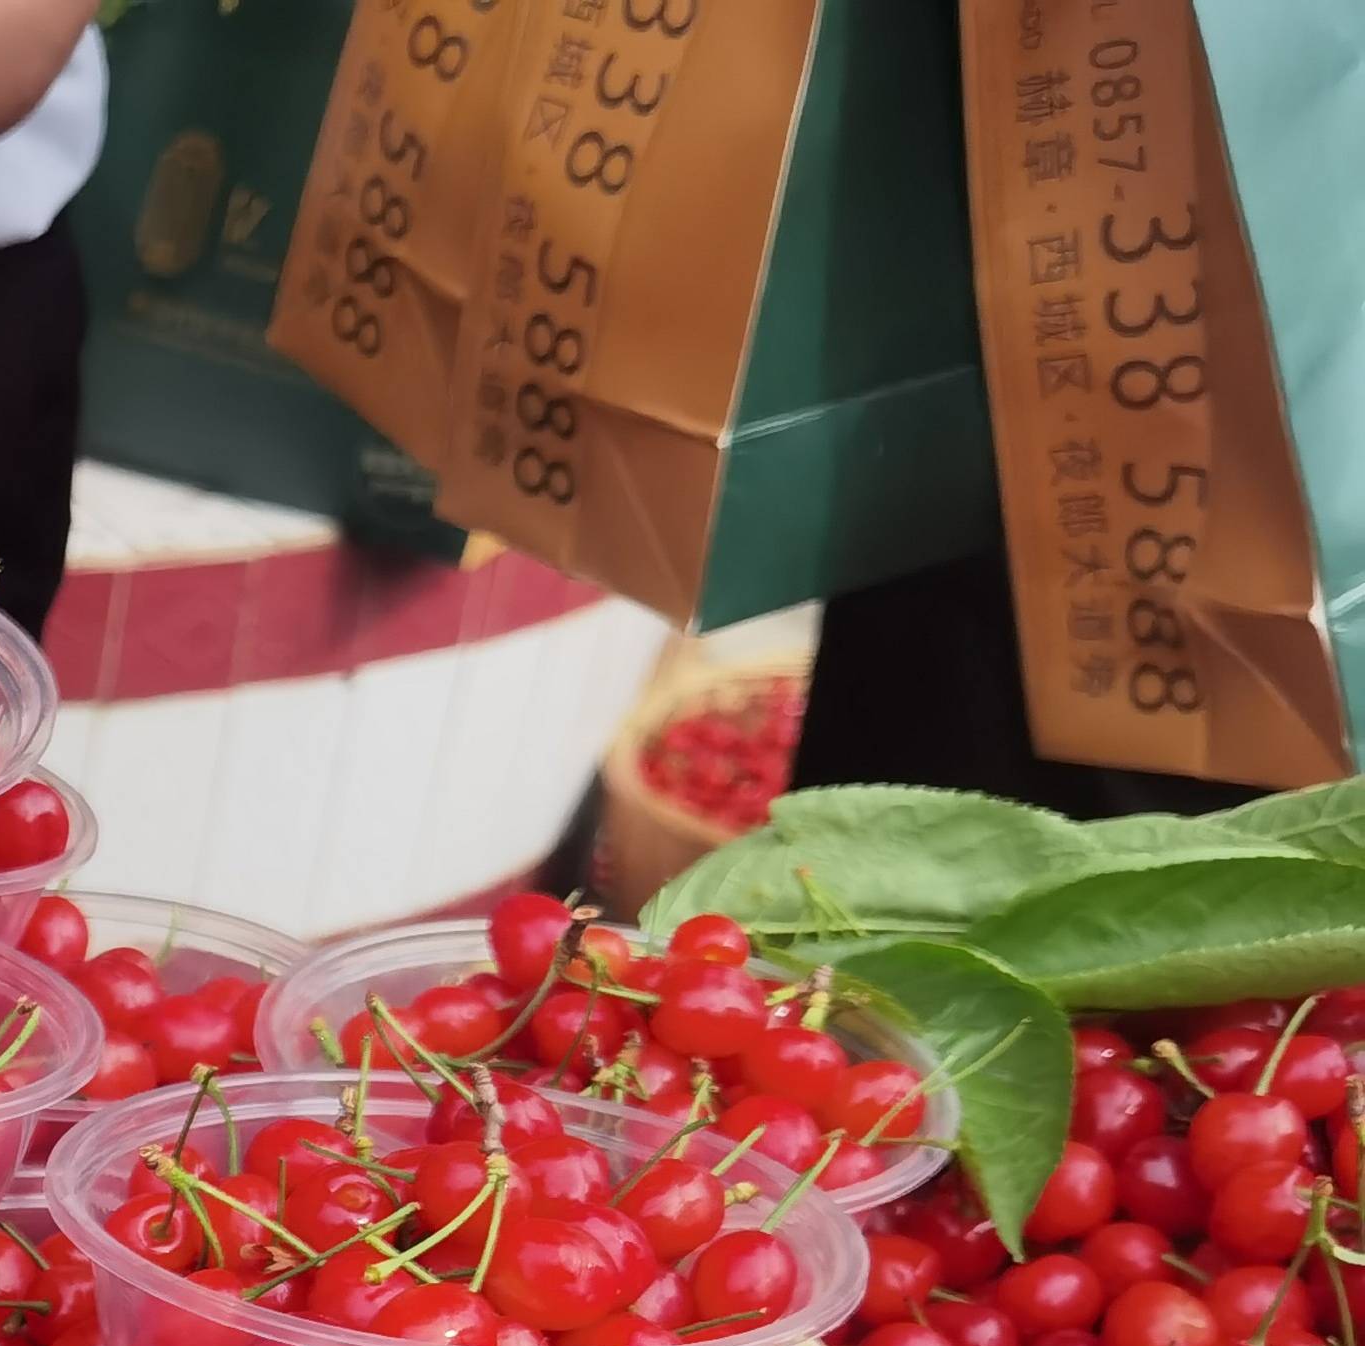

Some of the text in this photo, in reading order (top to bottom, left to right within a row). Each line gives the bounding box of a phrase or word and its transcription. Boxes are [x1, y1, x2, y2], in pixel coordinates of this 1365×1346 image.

[331, 109, 427, 358] 5888
[513, 238, 597, 505] 5888
[1122, 460, 1209, 715] 5888
